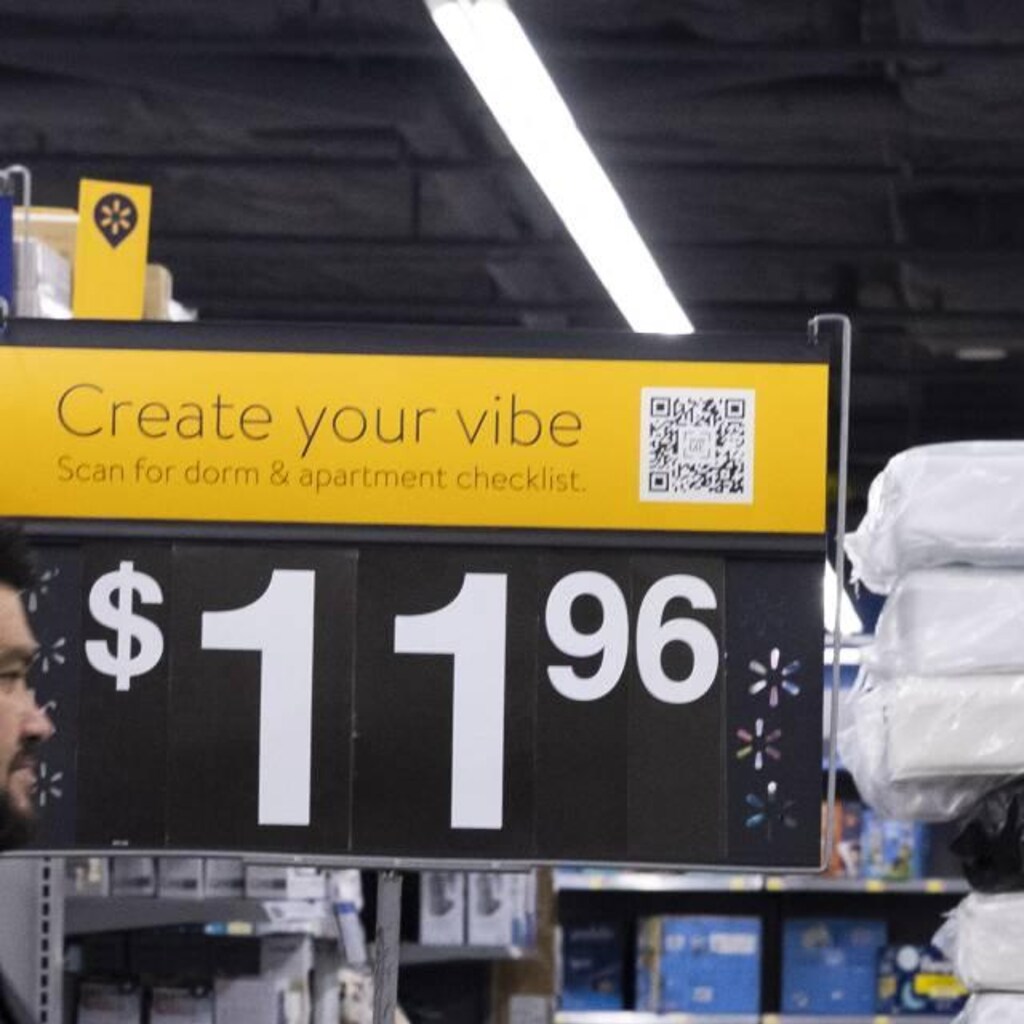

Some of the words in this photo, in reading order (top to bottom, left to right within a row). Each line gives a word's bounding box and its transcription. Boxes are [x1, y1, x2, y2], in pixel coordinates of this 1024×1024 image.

[57, 382, 273, 441] Create
[295, 404, 437, 459] your
[456, 392, 582, 448] vibe
[57, 455, 125, 483] Scan
[135, 456, 176, 484] for
[184, 460, 260, 486] dorm
[269, 460, 290, 487] &
[299, 465, 448, 494] apartment
[456, 465, 587, 493] checklist.
